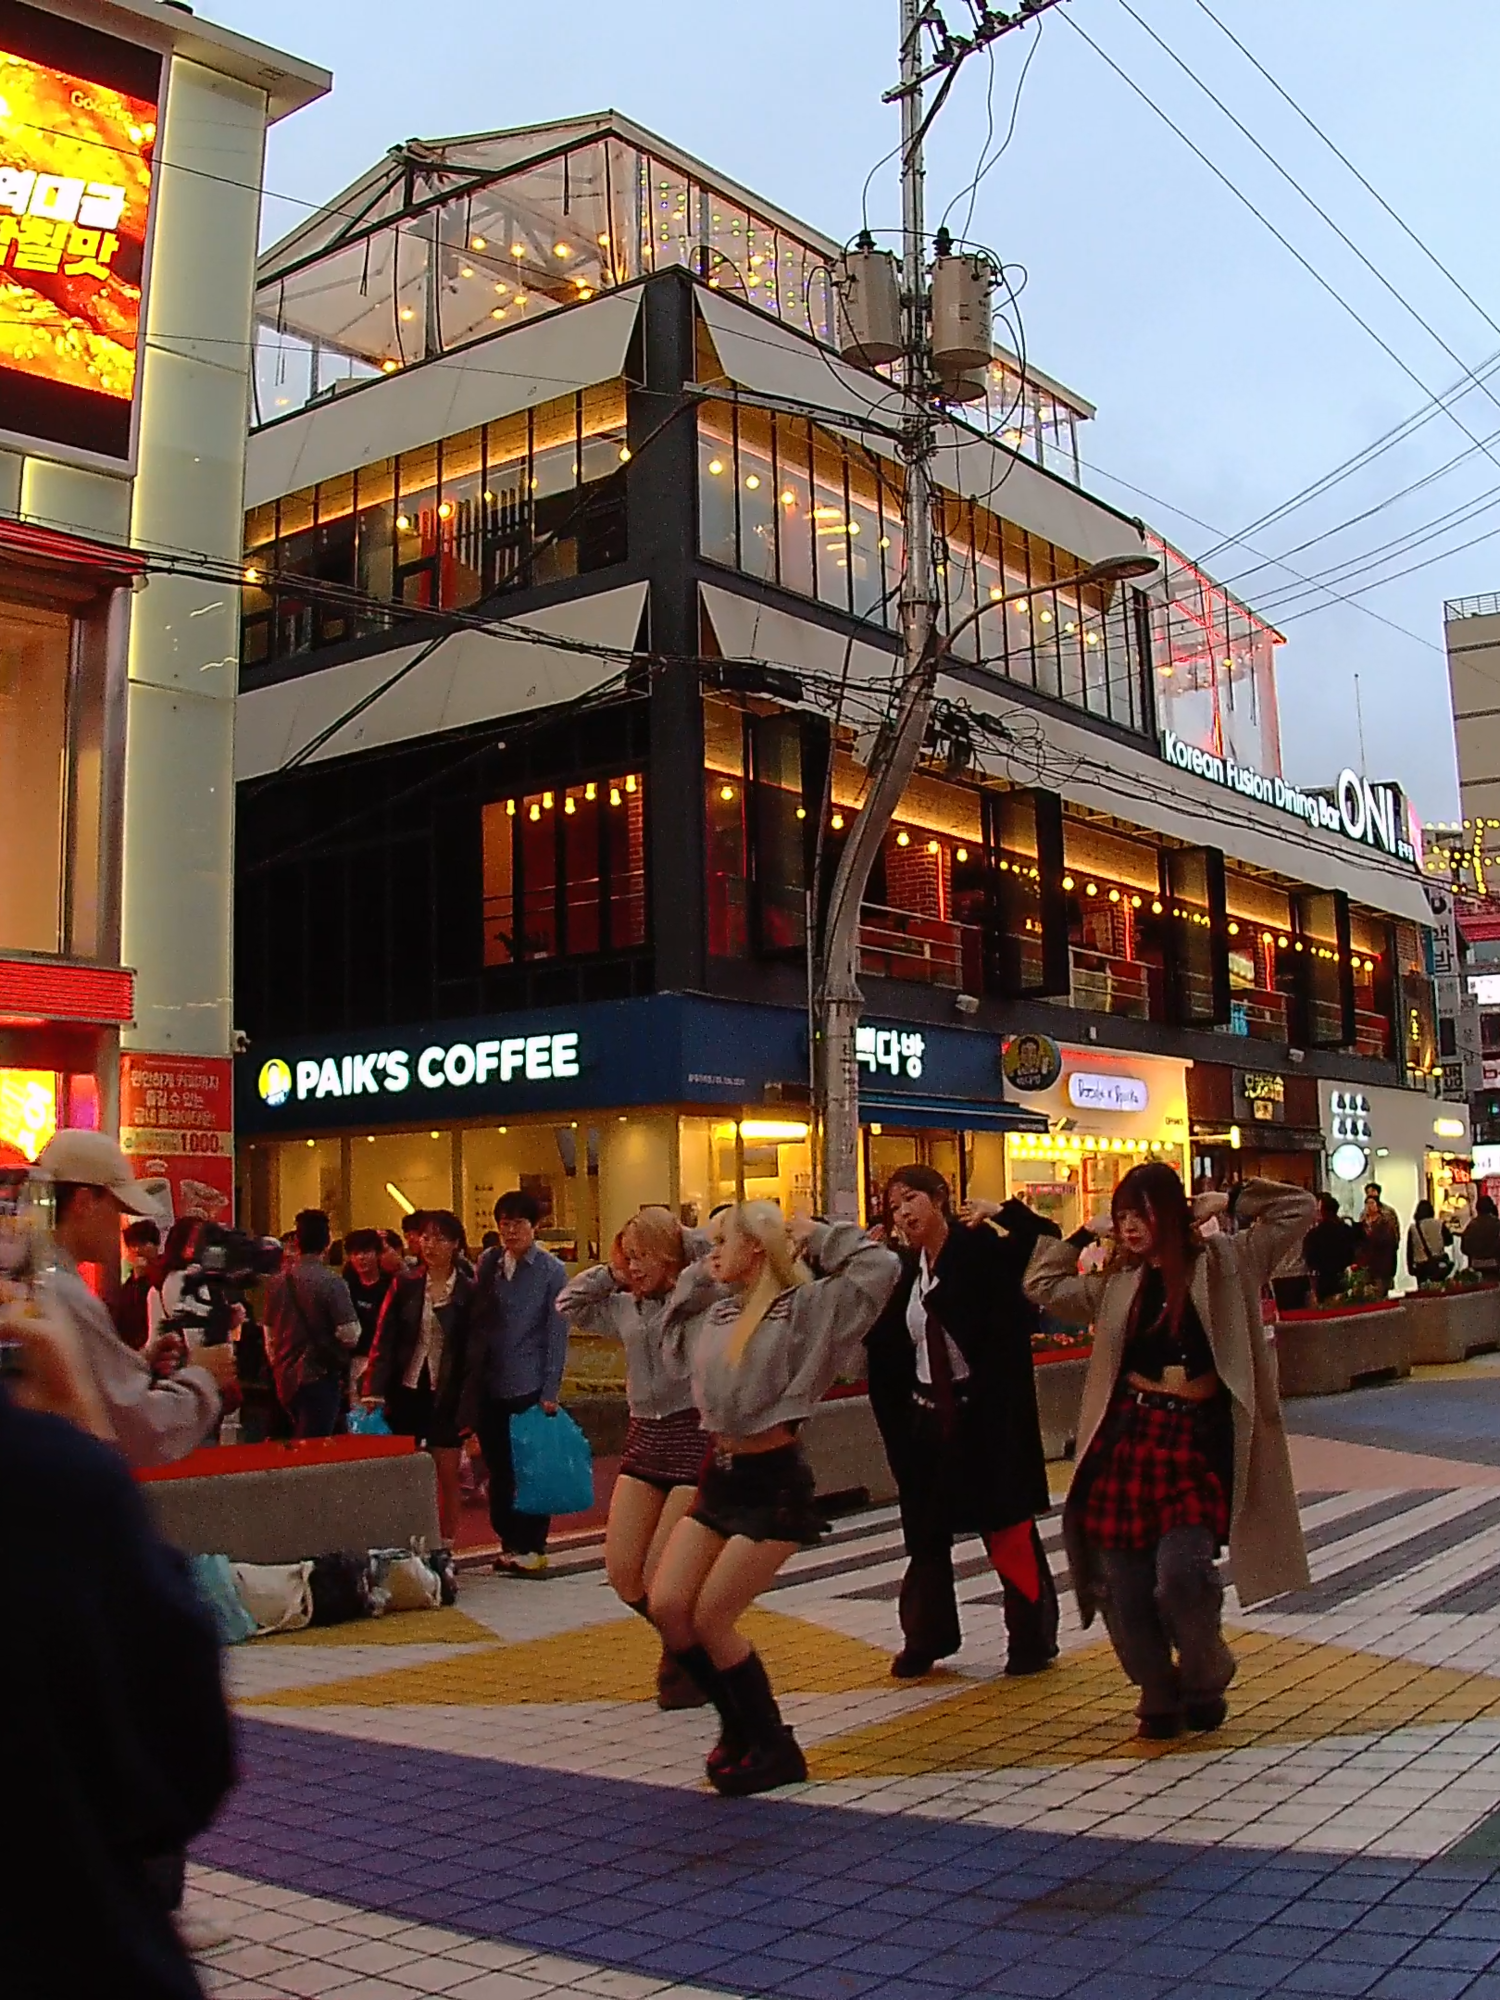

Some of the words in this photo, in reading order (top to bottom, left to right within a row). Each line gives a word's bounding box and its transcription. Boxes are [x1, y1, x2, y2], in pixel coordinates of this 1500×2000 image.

[1164, 730, 1226, 785] Korean
[1226, 757, 1273, 804] Fusion
[1274, 777, 1320, 828] Dining
[1319, 796, 1341, 832] Bar
[1337, 767, 1396, 854] ONI
[296, 1049, 410, 1101] PAIK'S
[417, 1032, 580, 1089] COFFEE
